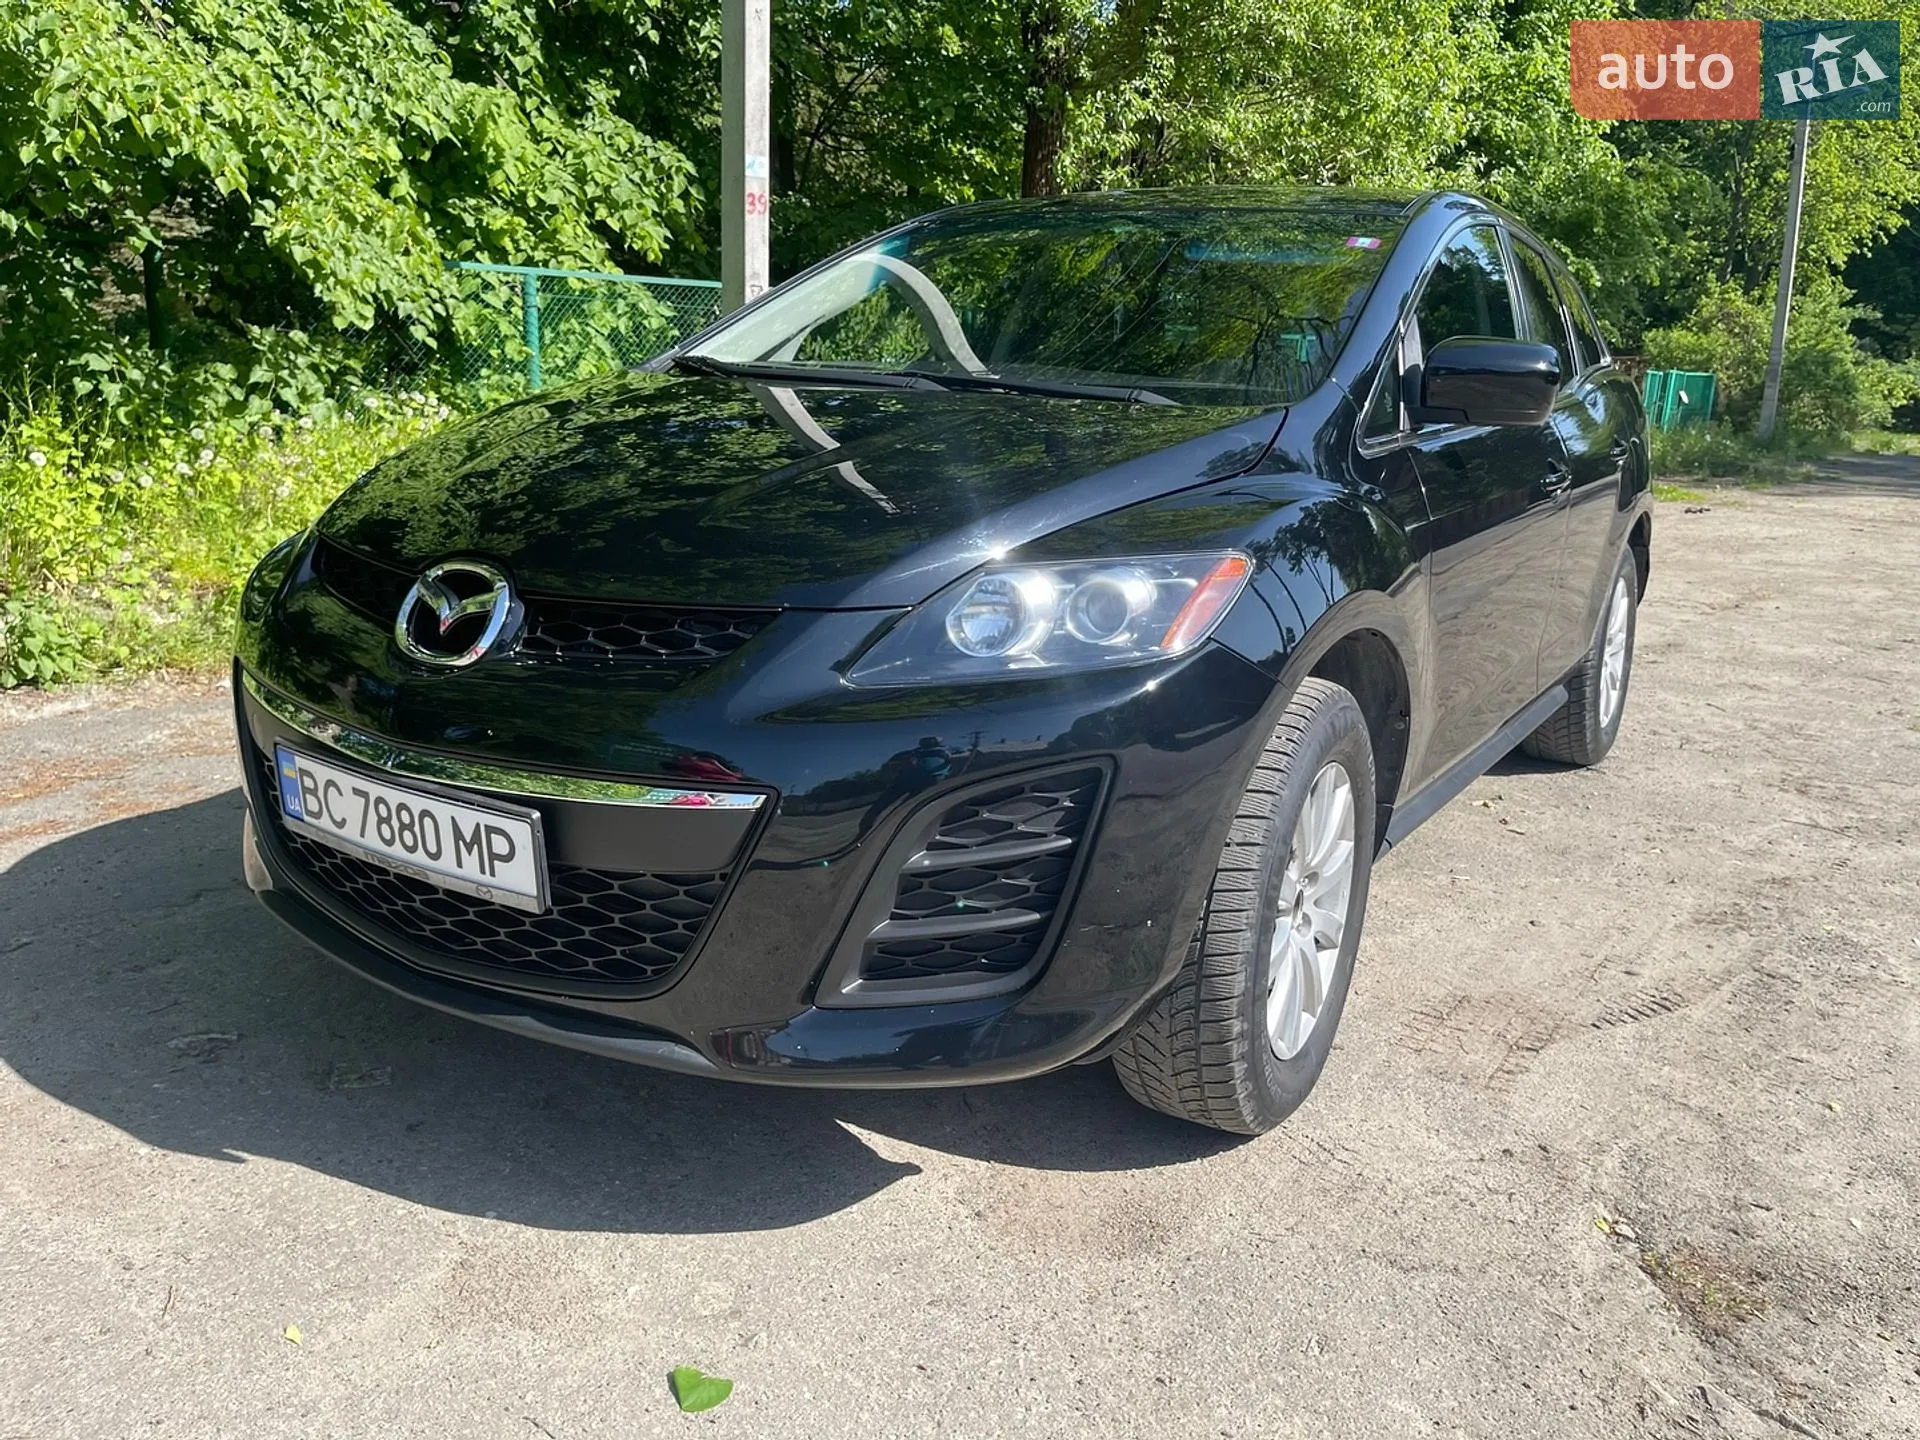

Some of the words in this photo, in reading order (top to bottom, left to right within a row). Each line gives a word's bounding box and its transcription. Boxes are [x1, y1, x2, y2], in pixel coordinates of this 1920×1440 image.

[747, 192, 767, 215] 39
[288, 796, 301, 811] UA
[299, 768, 347, 830] BC
[352, 786, 442, 861] 7880
[451, 815, 516, 878] MP
